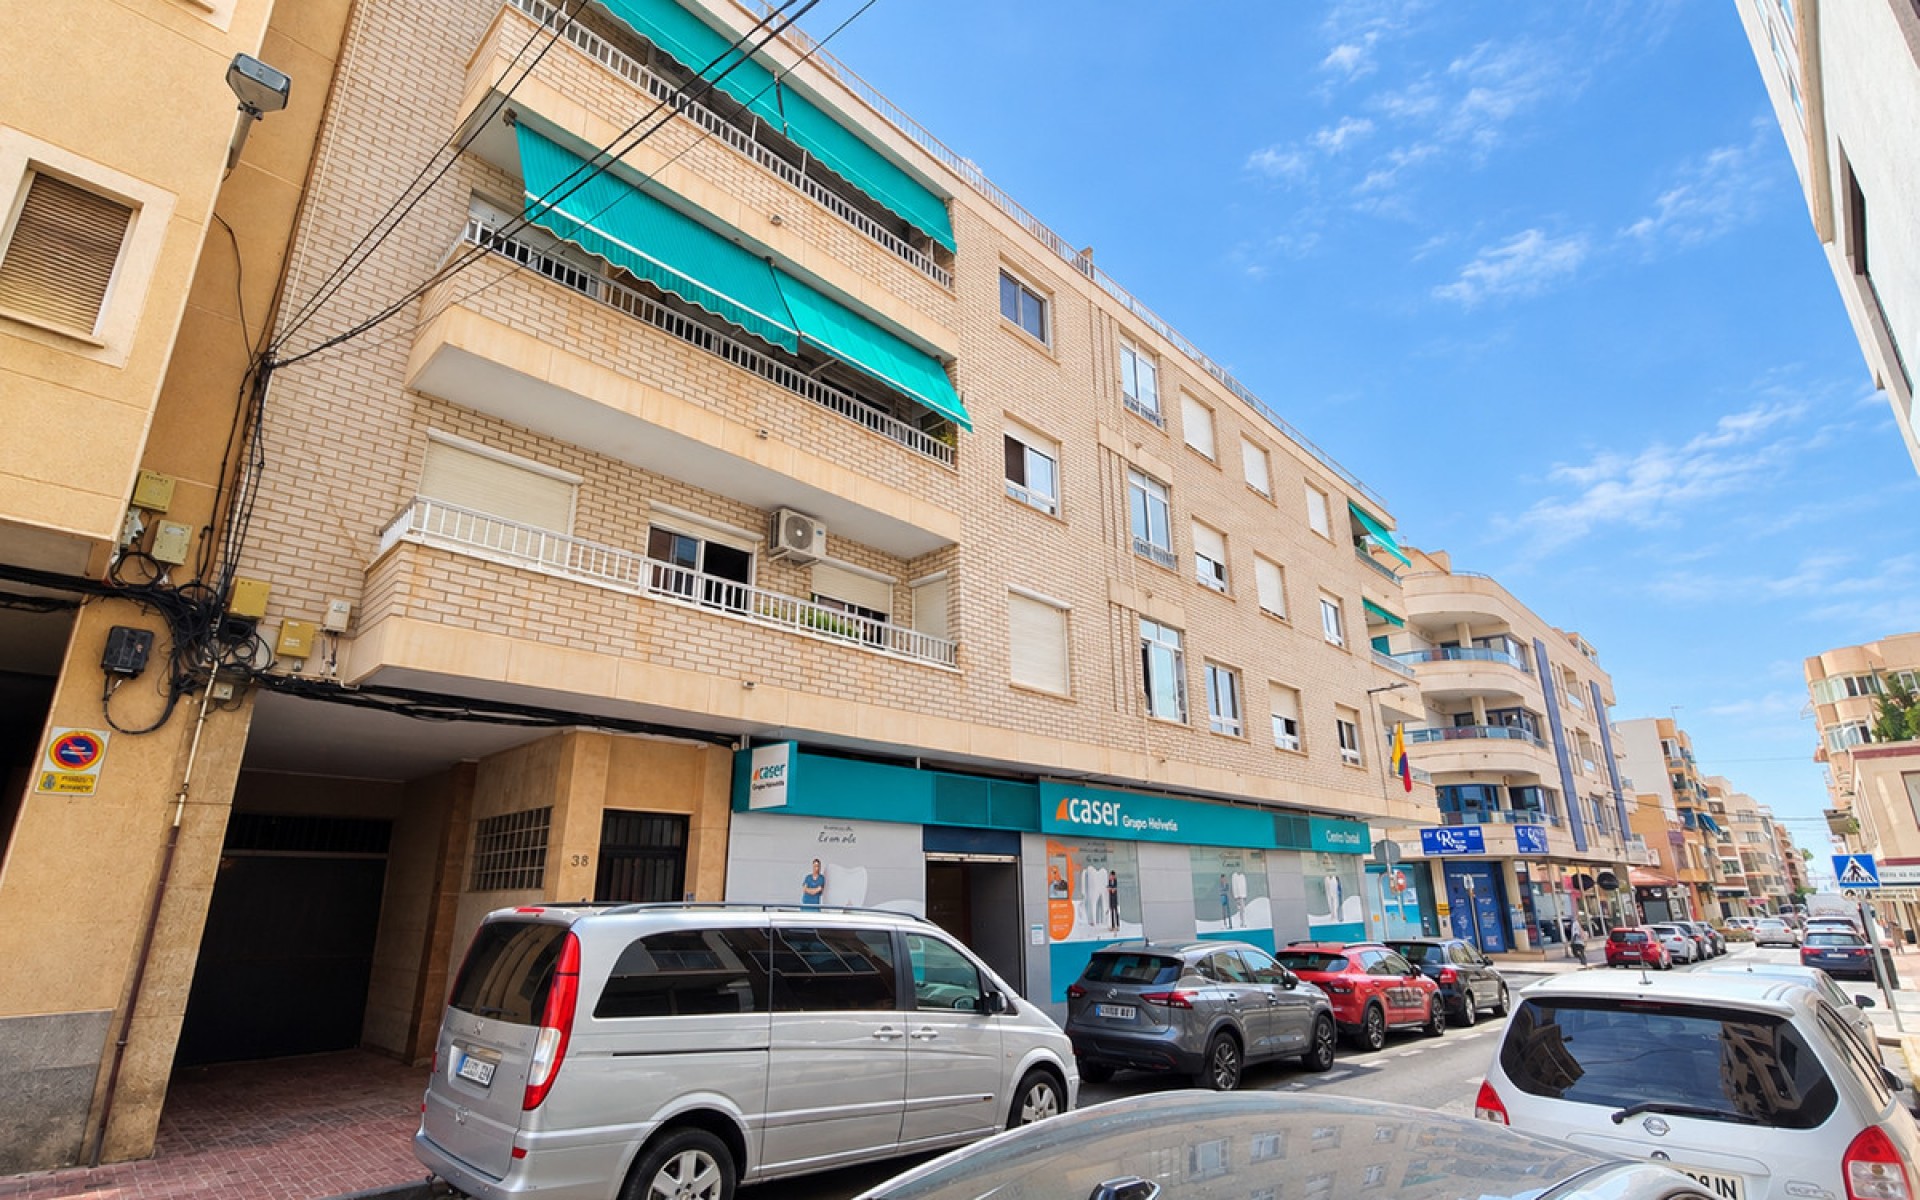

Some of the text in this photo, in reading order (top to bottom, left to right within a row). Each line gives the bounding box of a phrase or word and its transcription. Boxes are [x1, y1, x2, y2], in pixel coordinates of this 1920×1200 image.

[760, 763, 786, 779] caser
[1069, 798, 1120, 827] caser
[1122, 815, 1178, 832] Grupo Helvetia
[571, 854, 590, 867] 38
